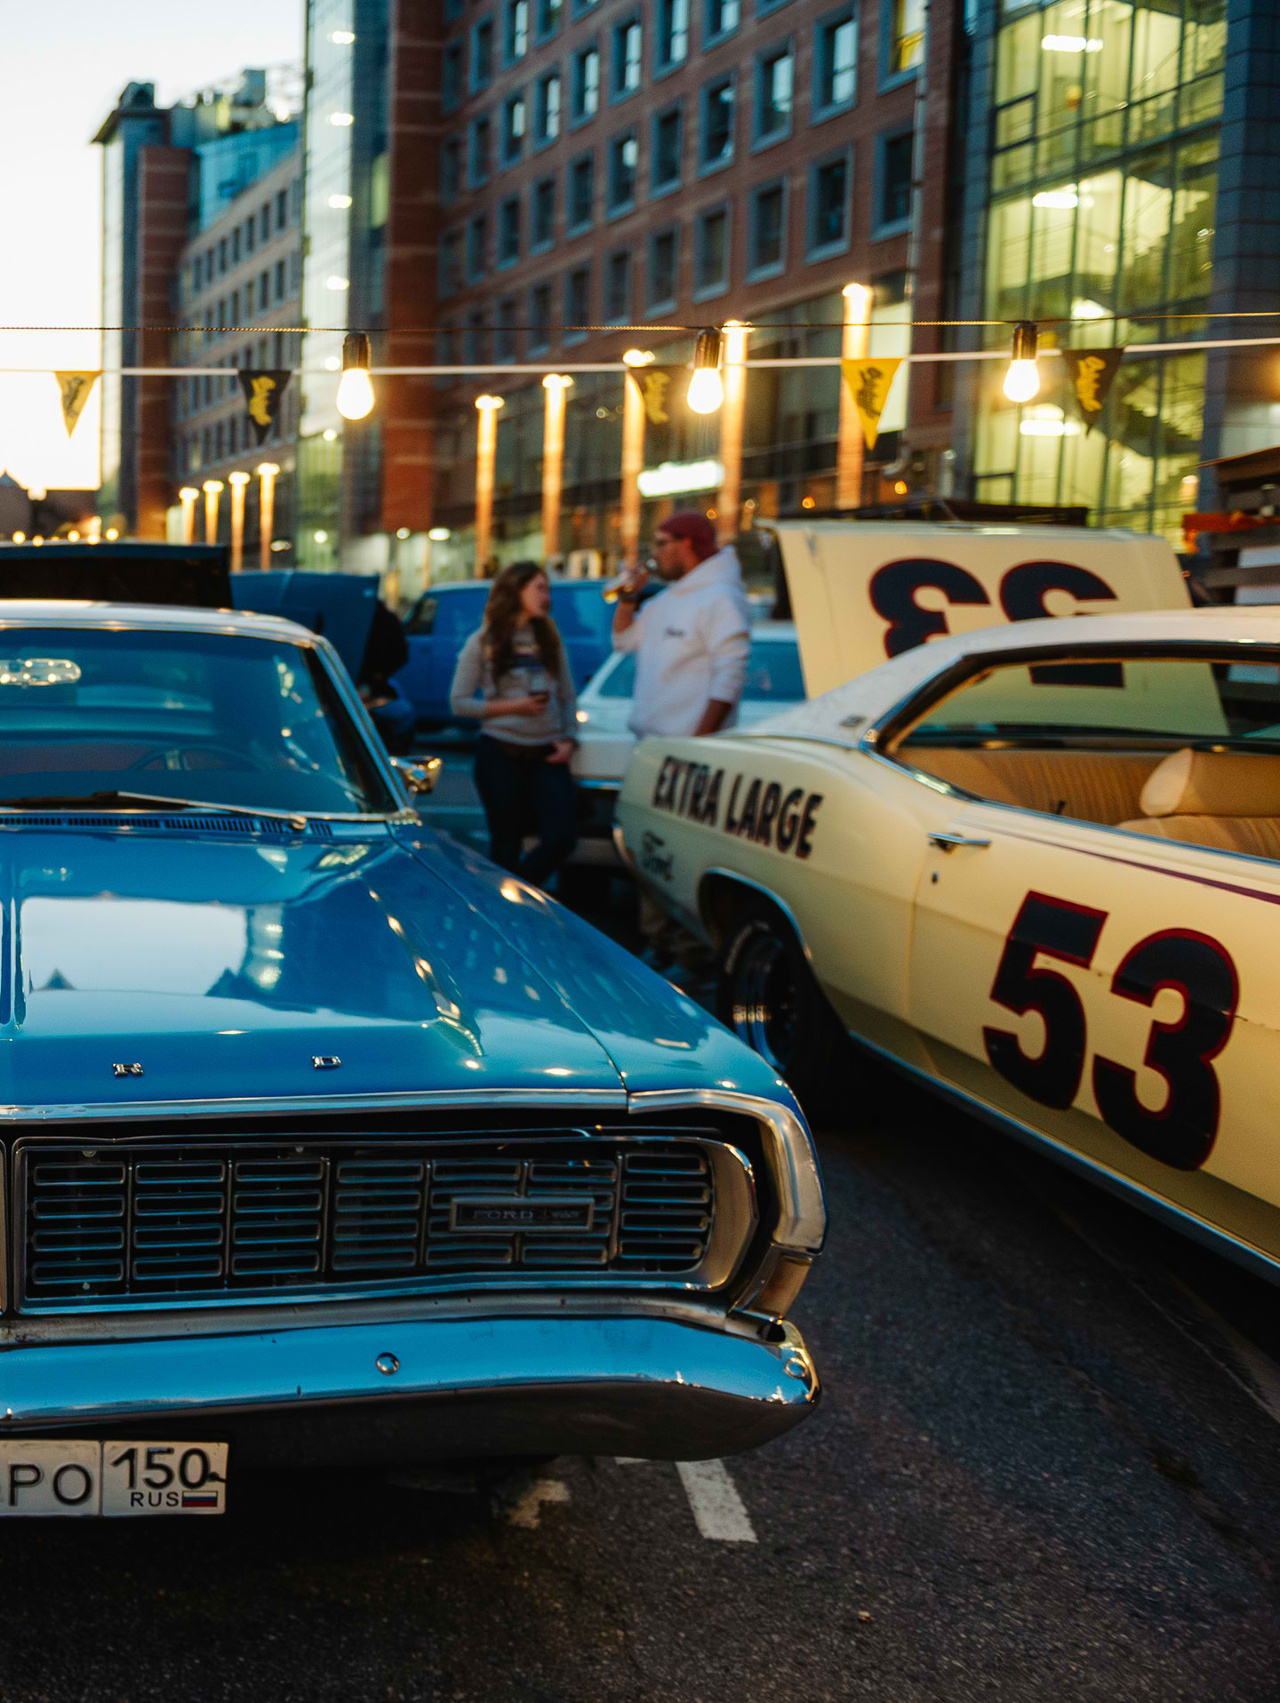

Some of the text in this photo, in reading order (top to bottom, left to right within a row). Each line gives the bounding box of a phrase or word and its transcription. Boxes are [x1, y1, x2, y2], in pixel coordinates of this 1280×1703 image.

[652, 755, 823, 860] EXTRA LARGE
[982, 890, 1240, 1172] 53
[110, 1447, 211, 1490] 150
[130, 1491, 180, 1508] RUS
